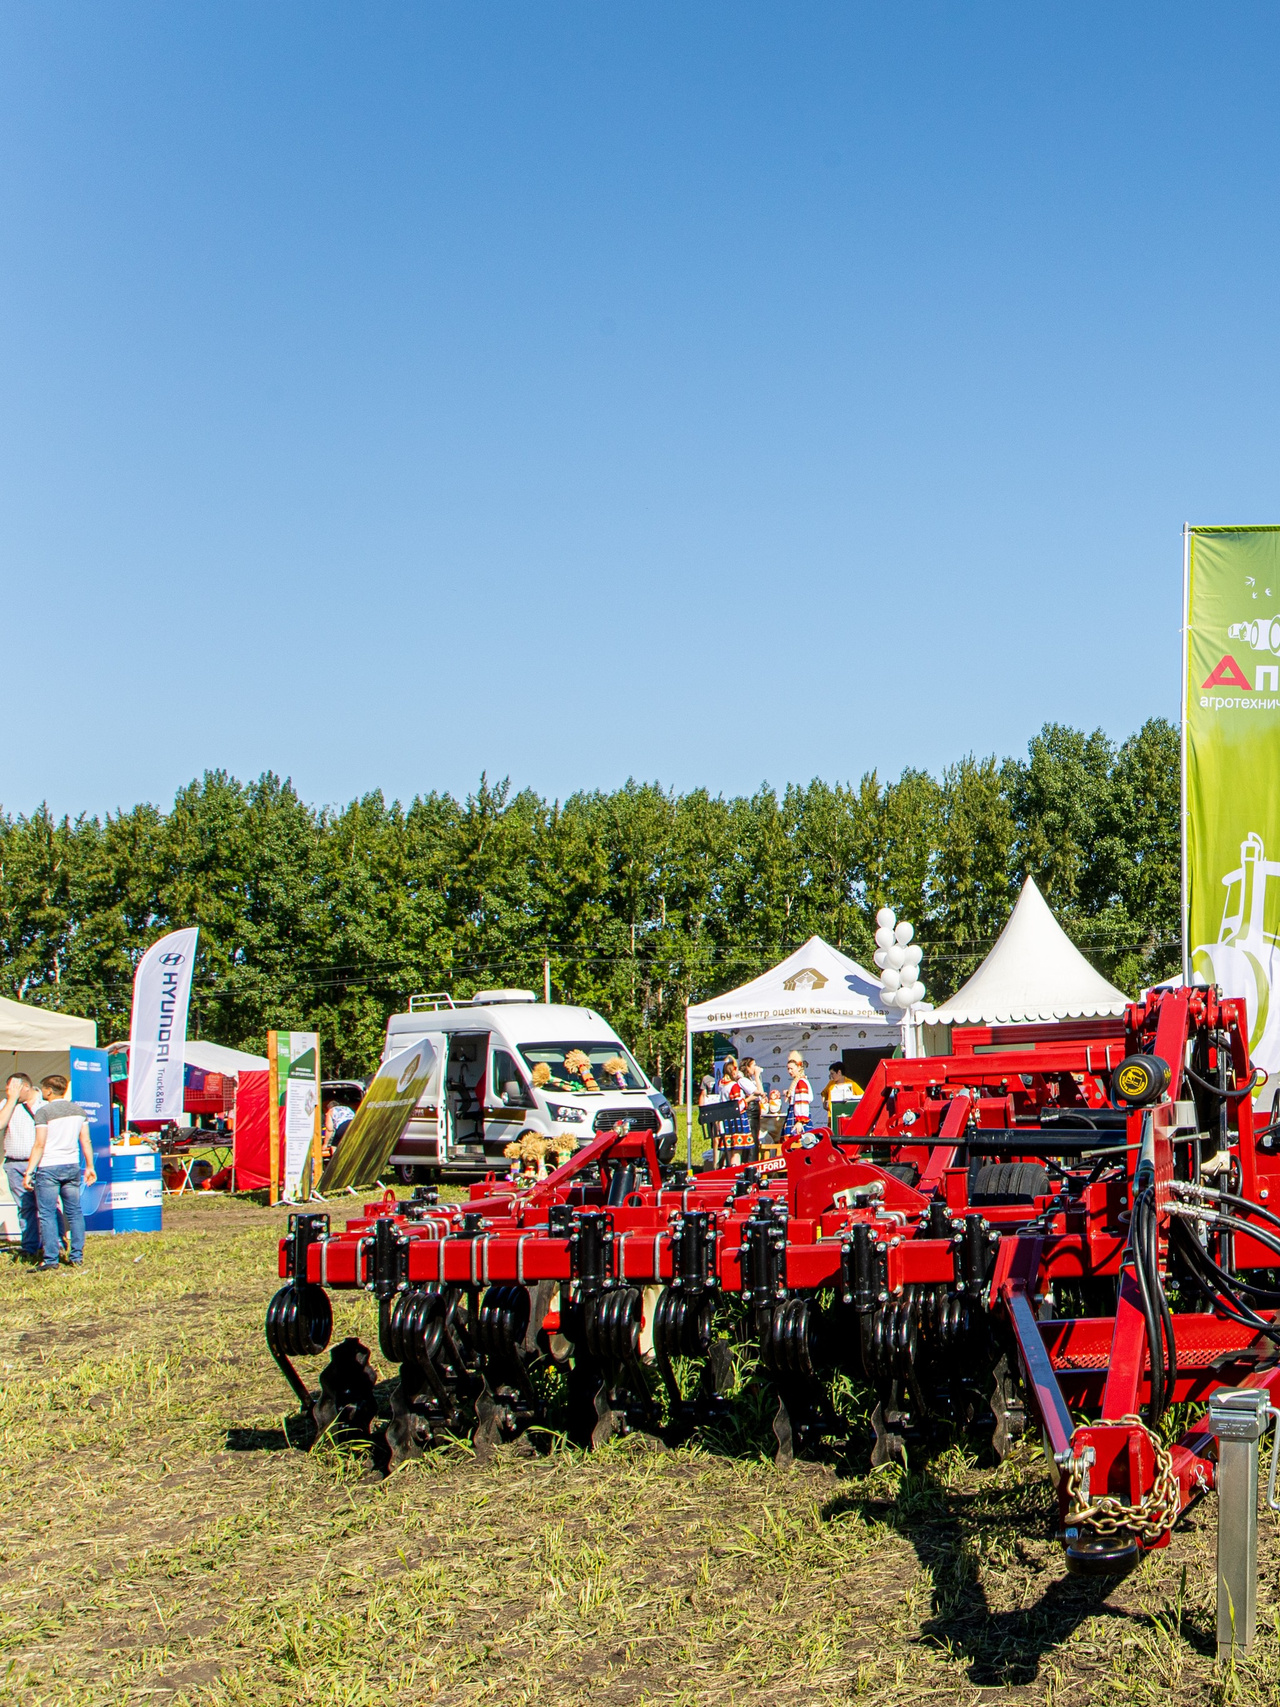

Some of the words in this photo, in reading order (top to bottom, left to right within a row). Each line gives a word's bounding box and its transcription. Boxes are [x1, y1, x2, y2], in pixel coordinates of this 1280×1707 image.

[156, 972, 179, 1063] HYUNDAI
[707, 1011, 732, 1022] ФГБУ
[772, 1007, 808, 1018] оценки
[155, 1067, 166, 1114] Truck&Bus
[748, 1157, 787, 1173] LFORD
